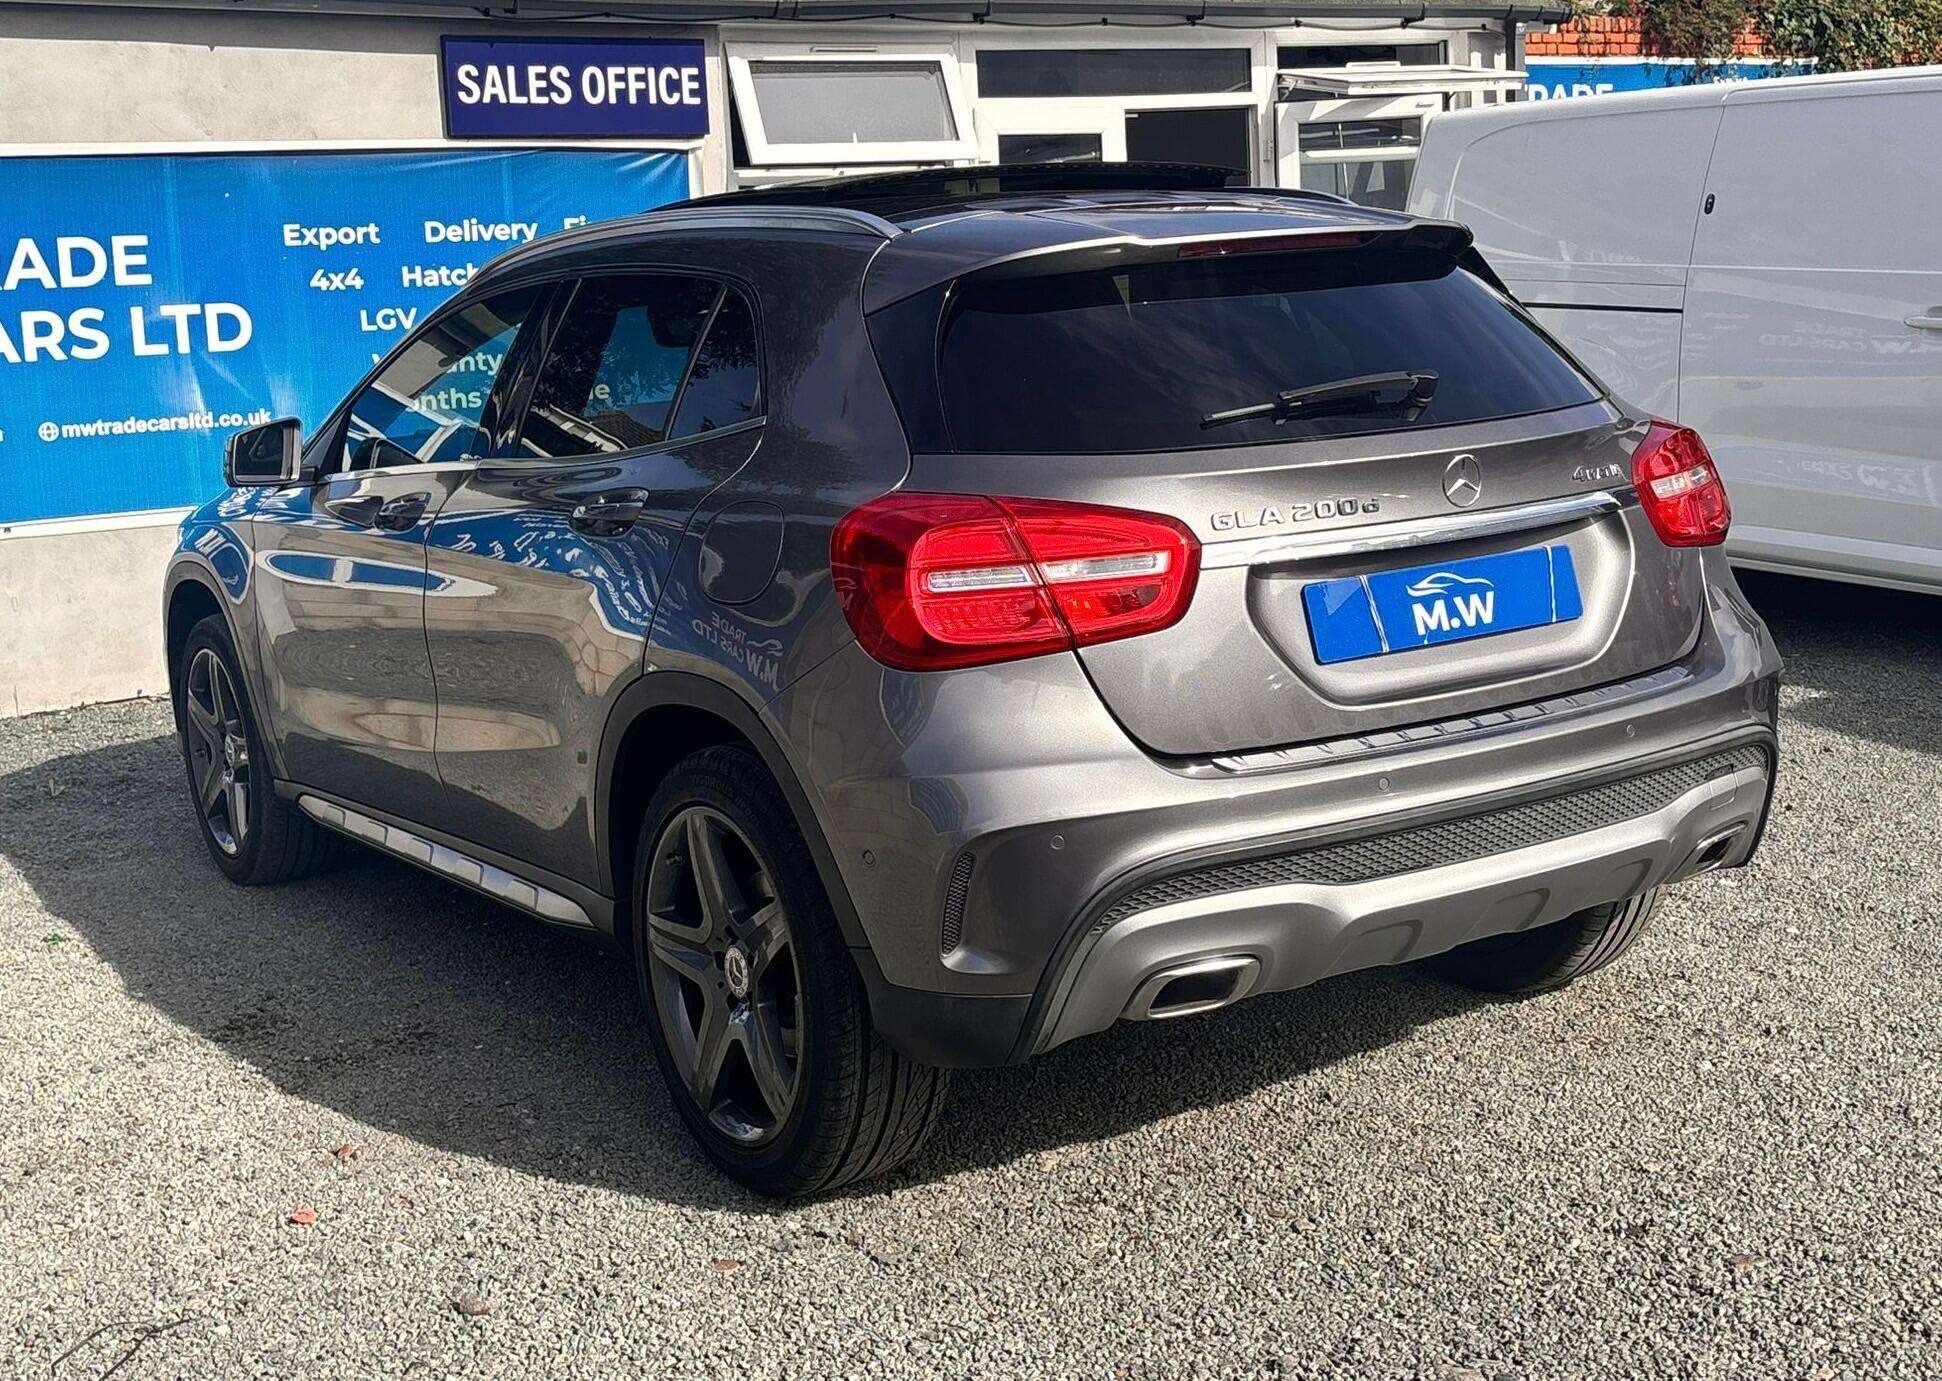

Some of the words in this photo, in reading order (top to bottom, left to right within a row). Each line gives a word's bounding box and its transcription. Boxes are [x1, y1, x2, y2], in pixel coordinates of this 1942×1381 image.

[457, 64, 571, 105] SALES
[581, 65, 701, 106] OFFICE
[1524, 83, 1613, 101] RAD
[283, 222, 381, 250] Export
[424, 217, 539, 244] Delivery
[0, 234, 153, 291] ADE
[309, 267, 365, 291] 4x4
[129, 302, 253, 356] LTD
[360, 307, 418, 332] LGV
[61, 408, 272, 439] mwtradecarsltd.co.uk
[1211, 505, 1285, 531] GLA
[1411, 591, 1495, 636] M.W
